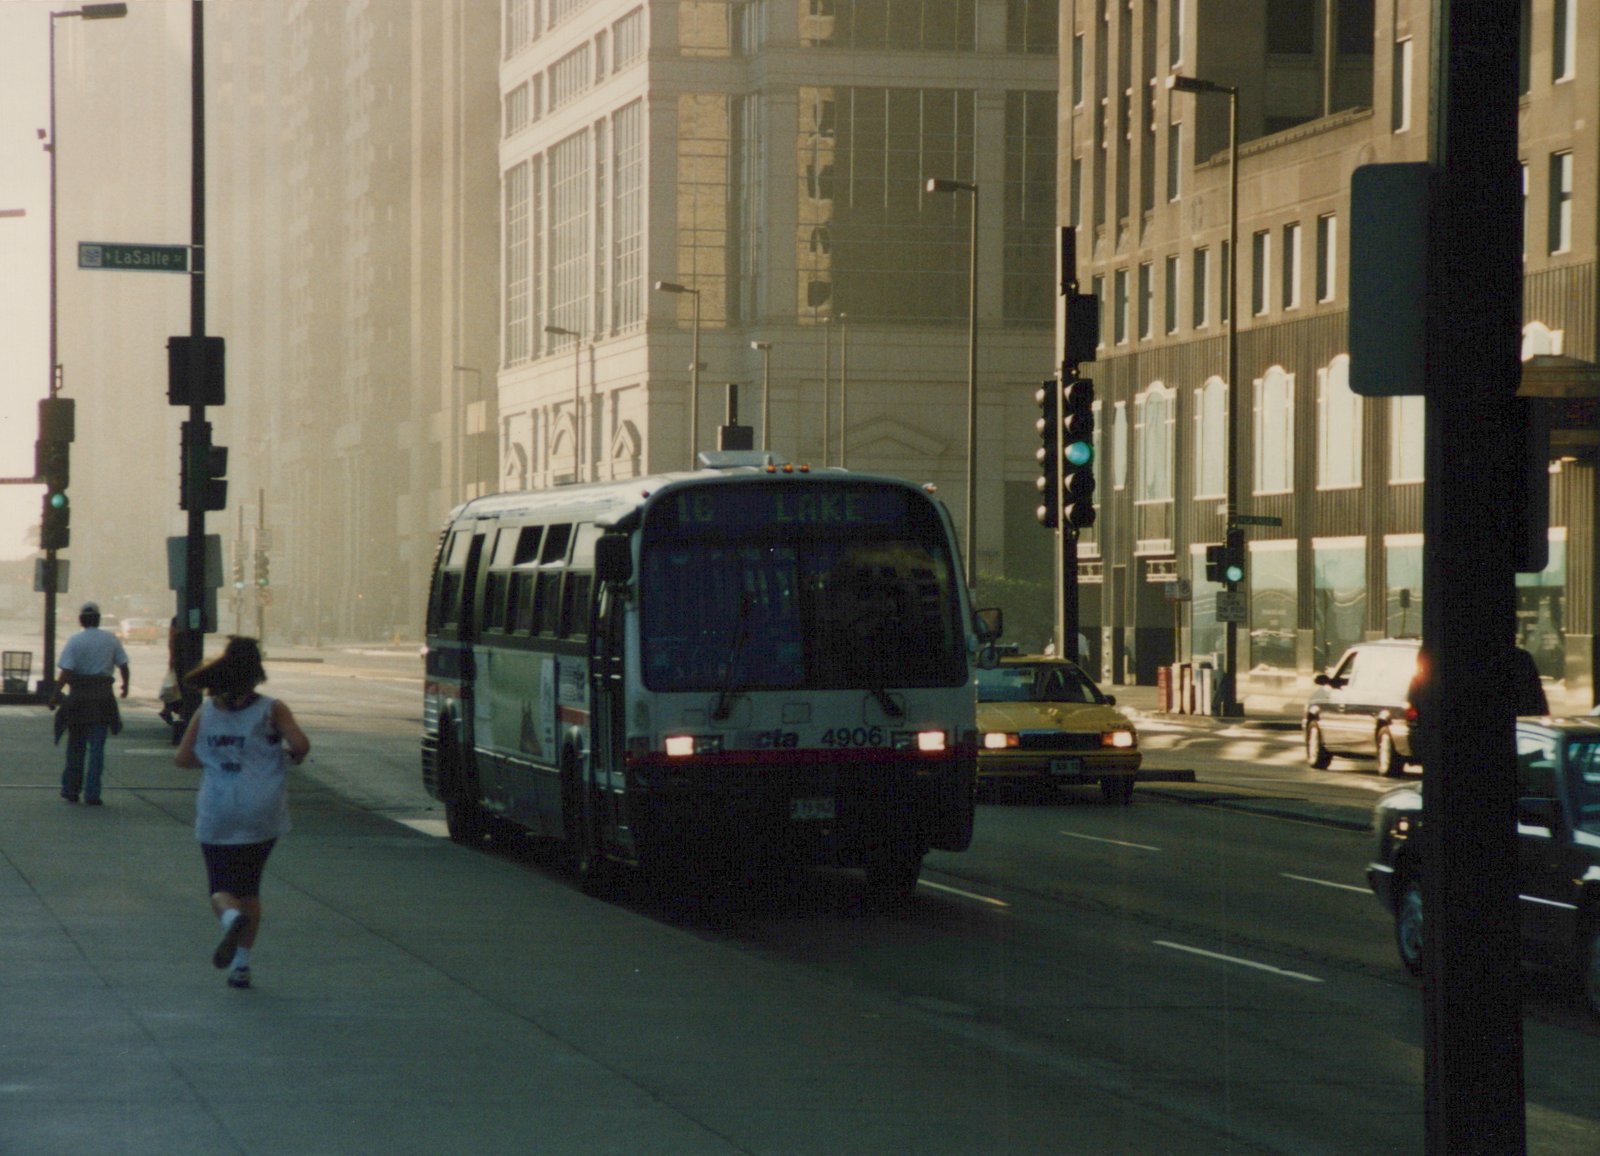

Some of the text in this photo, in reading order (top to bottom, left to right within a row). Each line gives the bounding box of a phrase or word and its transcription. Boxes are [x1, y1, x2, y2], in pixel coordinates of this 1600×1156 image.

[115, 250, 170, 265] LaSalle
[775, 493, 864, 521] LAKE
[752, 727, 882, 748] cta 4906
